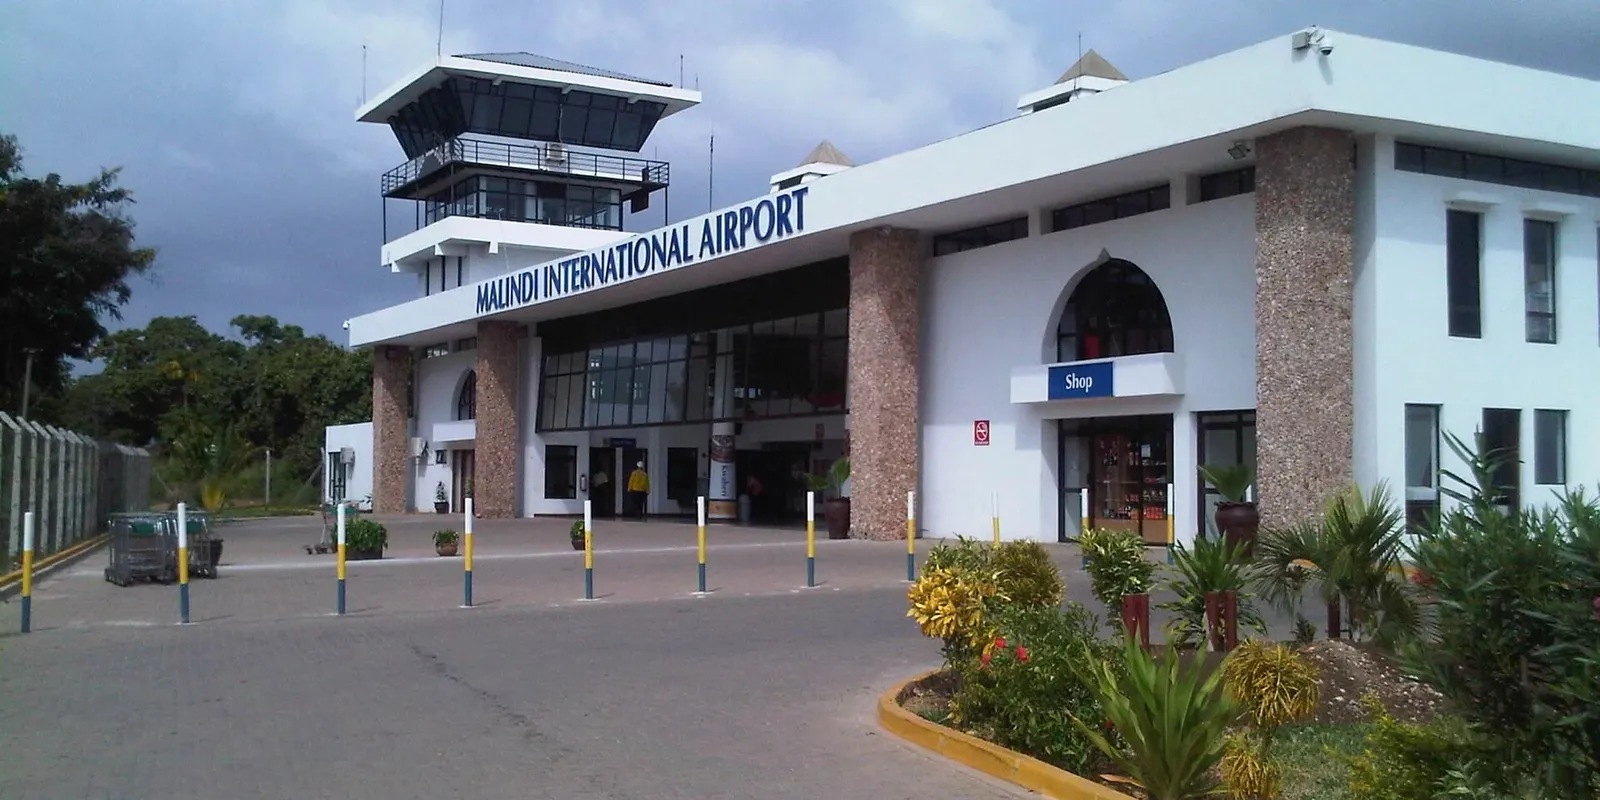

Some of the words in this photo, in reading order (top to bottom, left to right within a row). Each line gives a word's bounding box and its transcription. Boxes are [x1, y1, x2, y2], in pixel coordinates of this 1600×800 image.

[476, 272, 539, 314] MALINDI
[543, 223, 694, 298] INTERNATIONAL
[699, 187, 809, 259] AIRPORT
[1065, 373, 1093, 393] Shop
